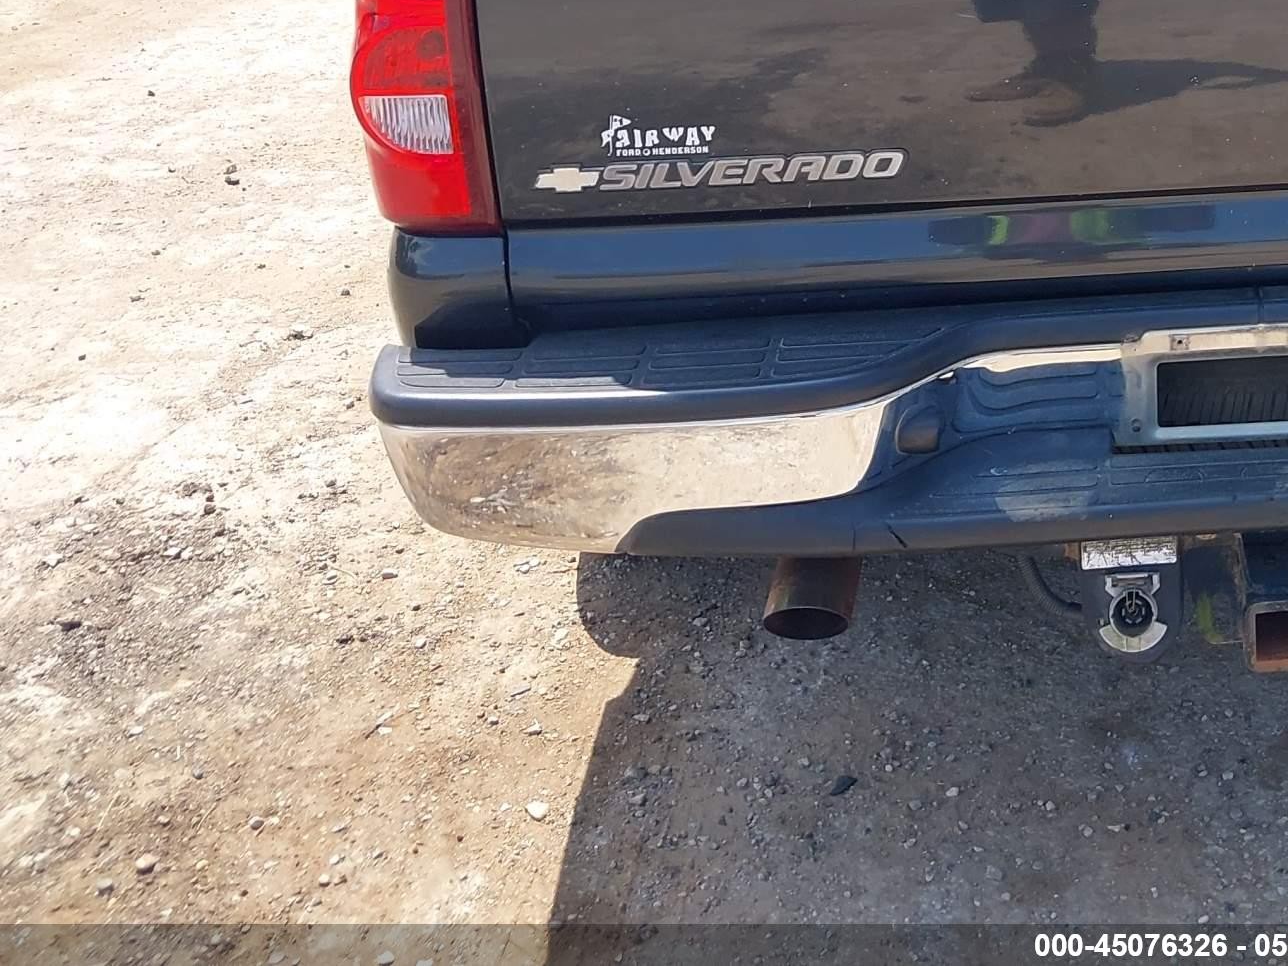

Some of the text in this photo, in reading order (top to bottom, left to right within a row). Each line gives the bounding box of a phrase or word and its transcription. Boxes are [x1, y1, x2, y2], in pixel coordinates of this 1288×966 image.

[616, 145, 709, 157] FORD HENDERSON
[599, 150, 905, 192] SILVERADO
